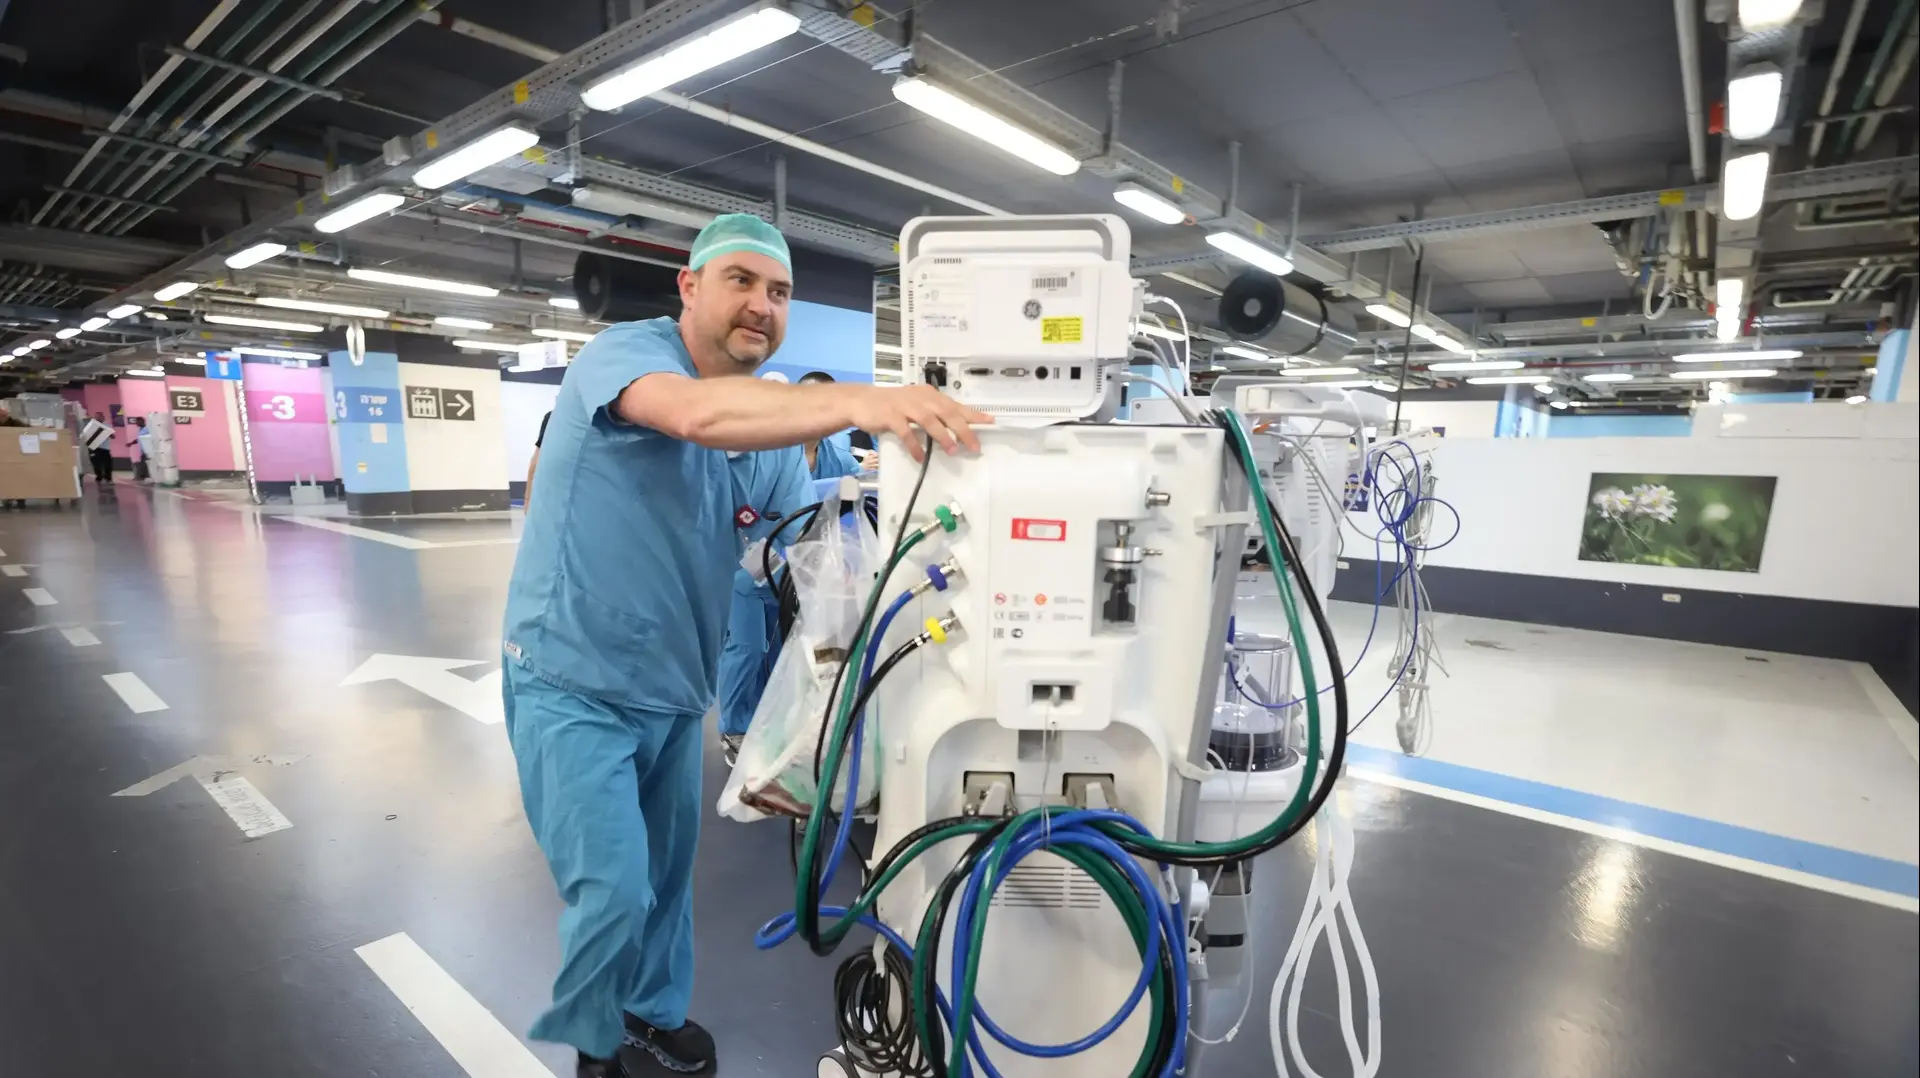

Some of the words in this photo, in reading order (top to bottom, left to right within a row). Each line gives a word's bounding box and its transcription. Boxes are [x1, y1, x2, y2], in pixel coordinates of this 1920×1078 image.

[177, 395, 197, 408] E3
[261, 395, 296, 420] -3
[368, 407, 383, 416] 16
